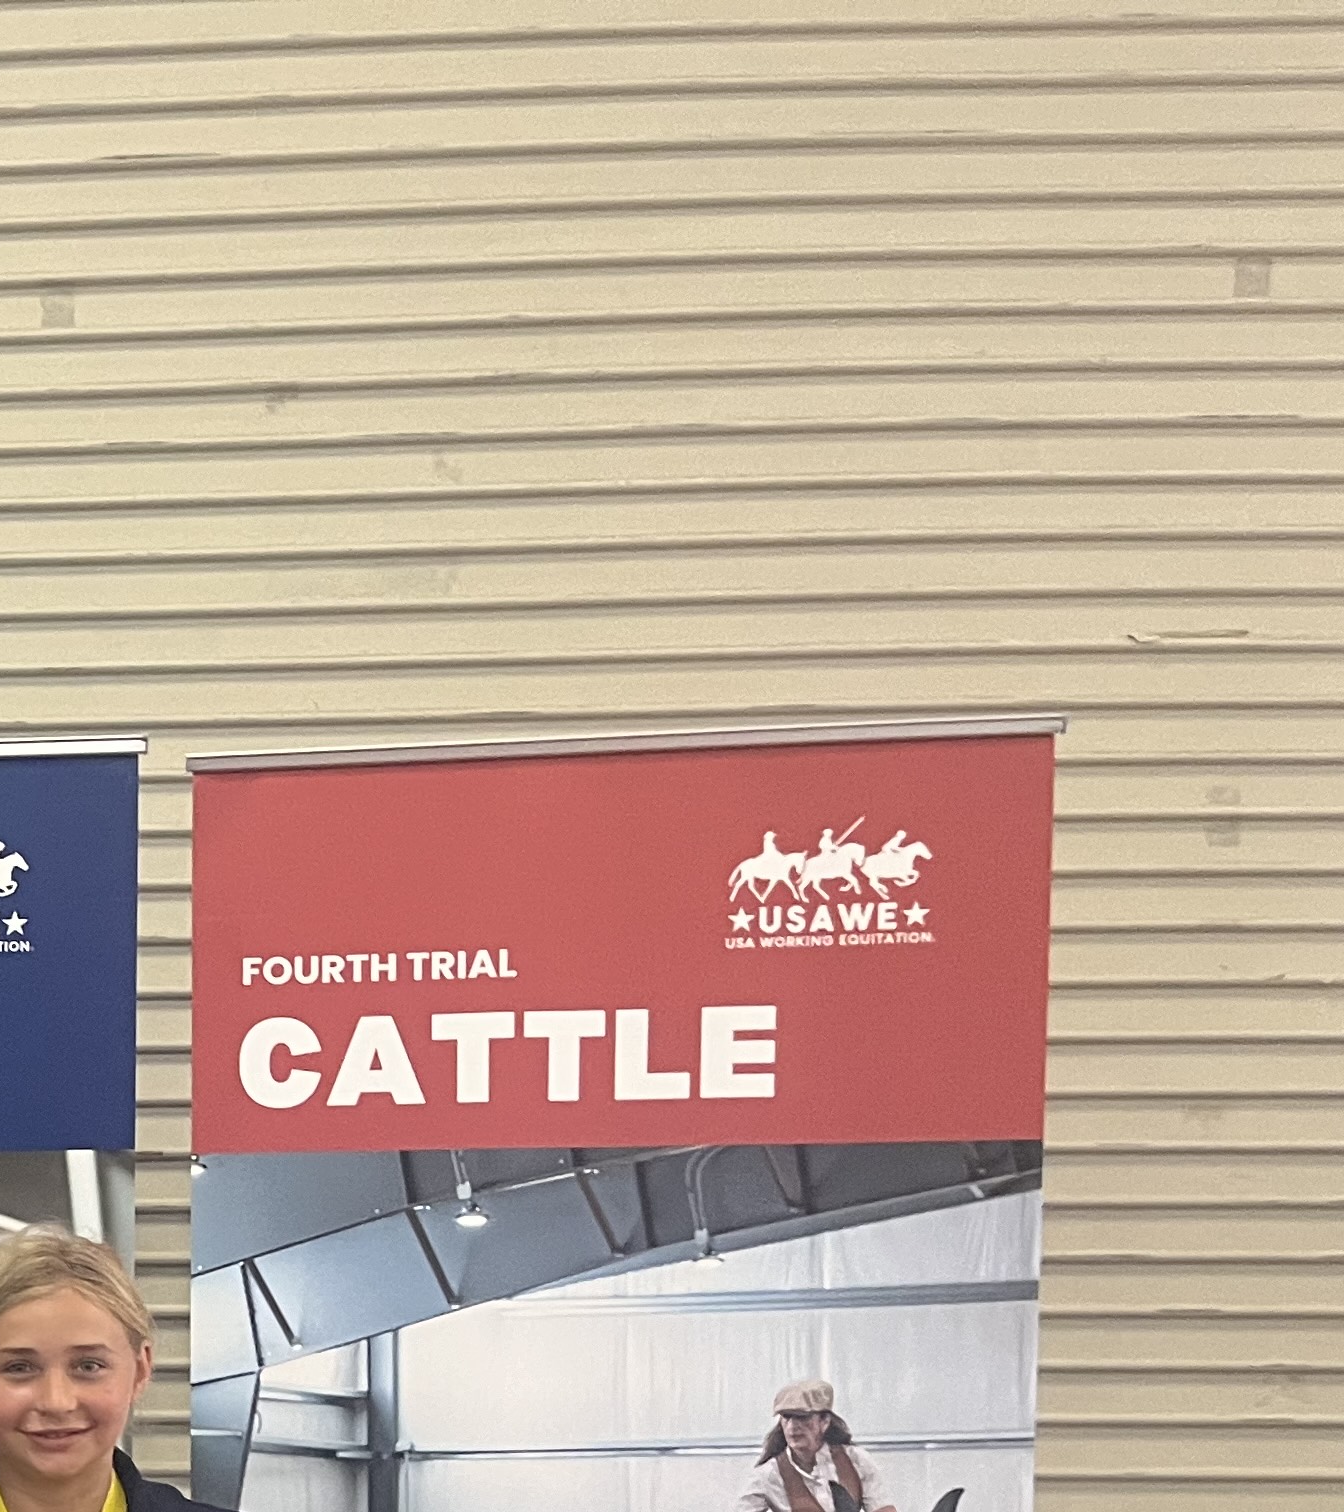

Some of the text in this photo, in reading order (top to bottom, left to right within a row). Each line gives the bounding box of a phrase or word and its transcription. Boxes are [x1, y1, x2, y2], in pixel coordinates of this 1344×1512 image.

[758, 902, 900, 935] USAWE
[725, 931, 933, 950] USA WORKING EQUITATION
[241, 948, 517, 986] FOURTH TRIAL
[238, 1004, 777, 1109] CATTLE
